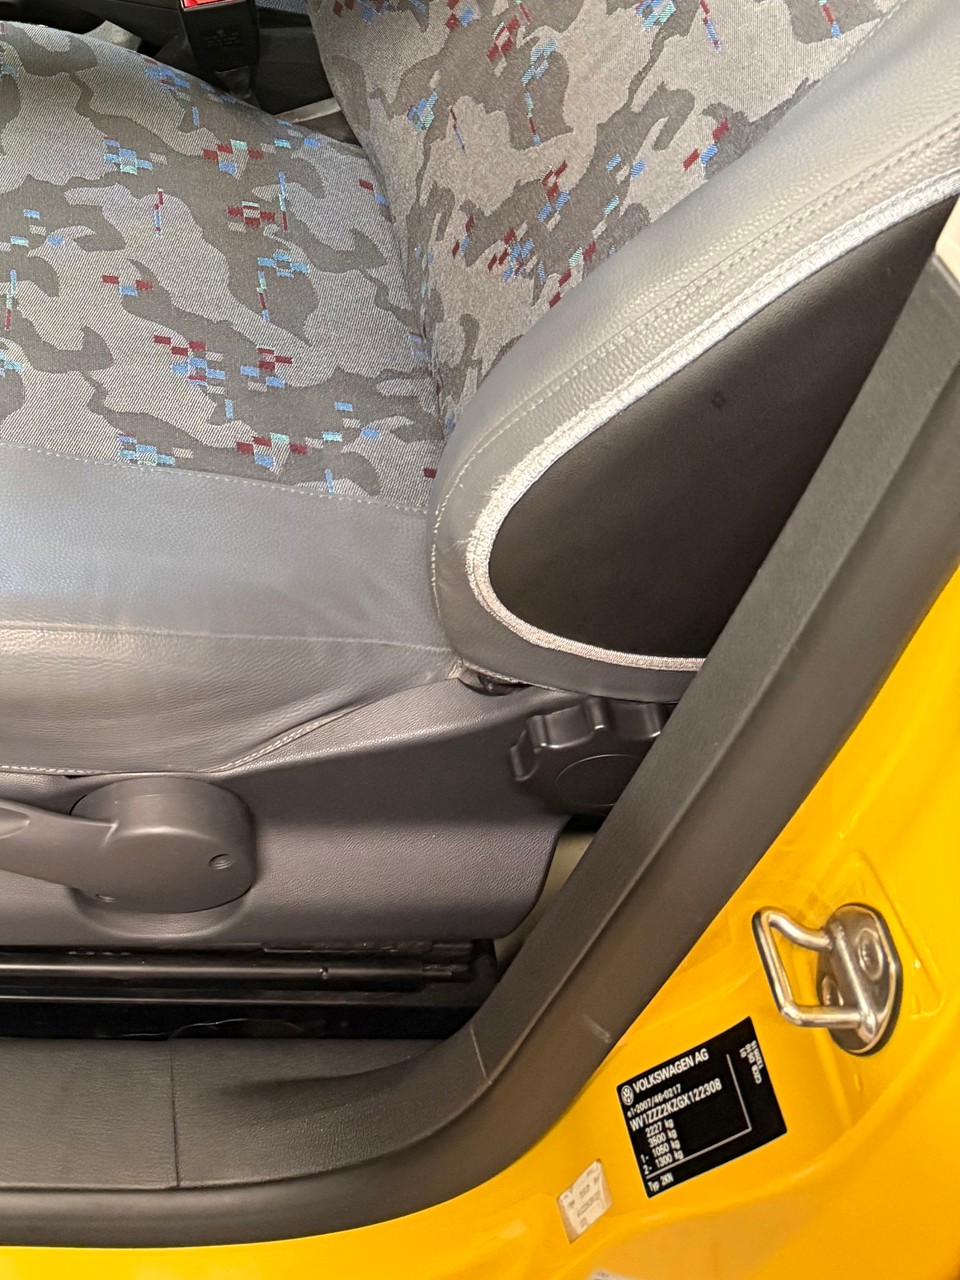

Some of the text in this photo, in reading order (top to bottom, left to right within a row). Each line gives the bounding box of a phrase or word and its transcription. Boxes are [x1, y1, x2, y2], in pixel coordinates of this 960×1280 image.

[633, 1048, 709, 1094] VOLKSWAGEN AG
[629, 1077, 723, 1132] WV1ZZZ2KZGX122308
[645, 1118, 675, 1138] 2227 kg
[647, 1128, 678, 1148] 3500 kg
[670, 1139, 681, 1150] kg
[655, 1152, 673, 1168] 1300
[673, 1149, 684, 1160] kg
